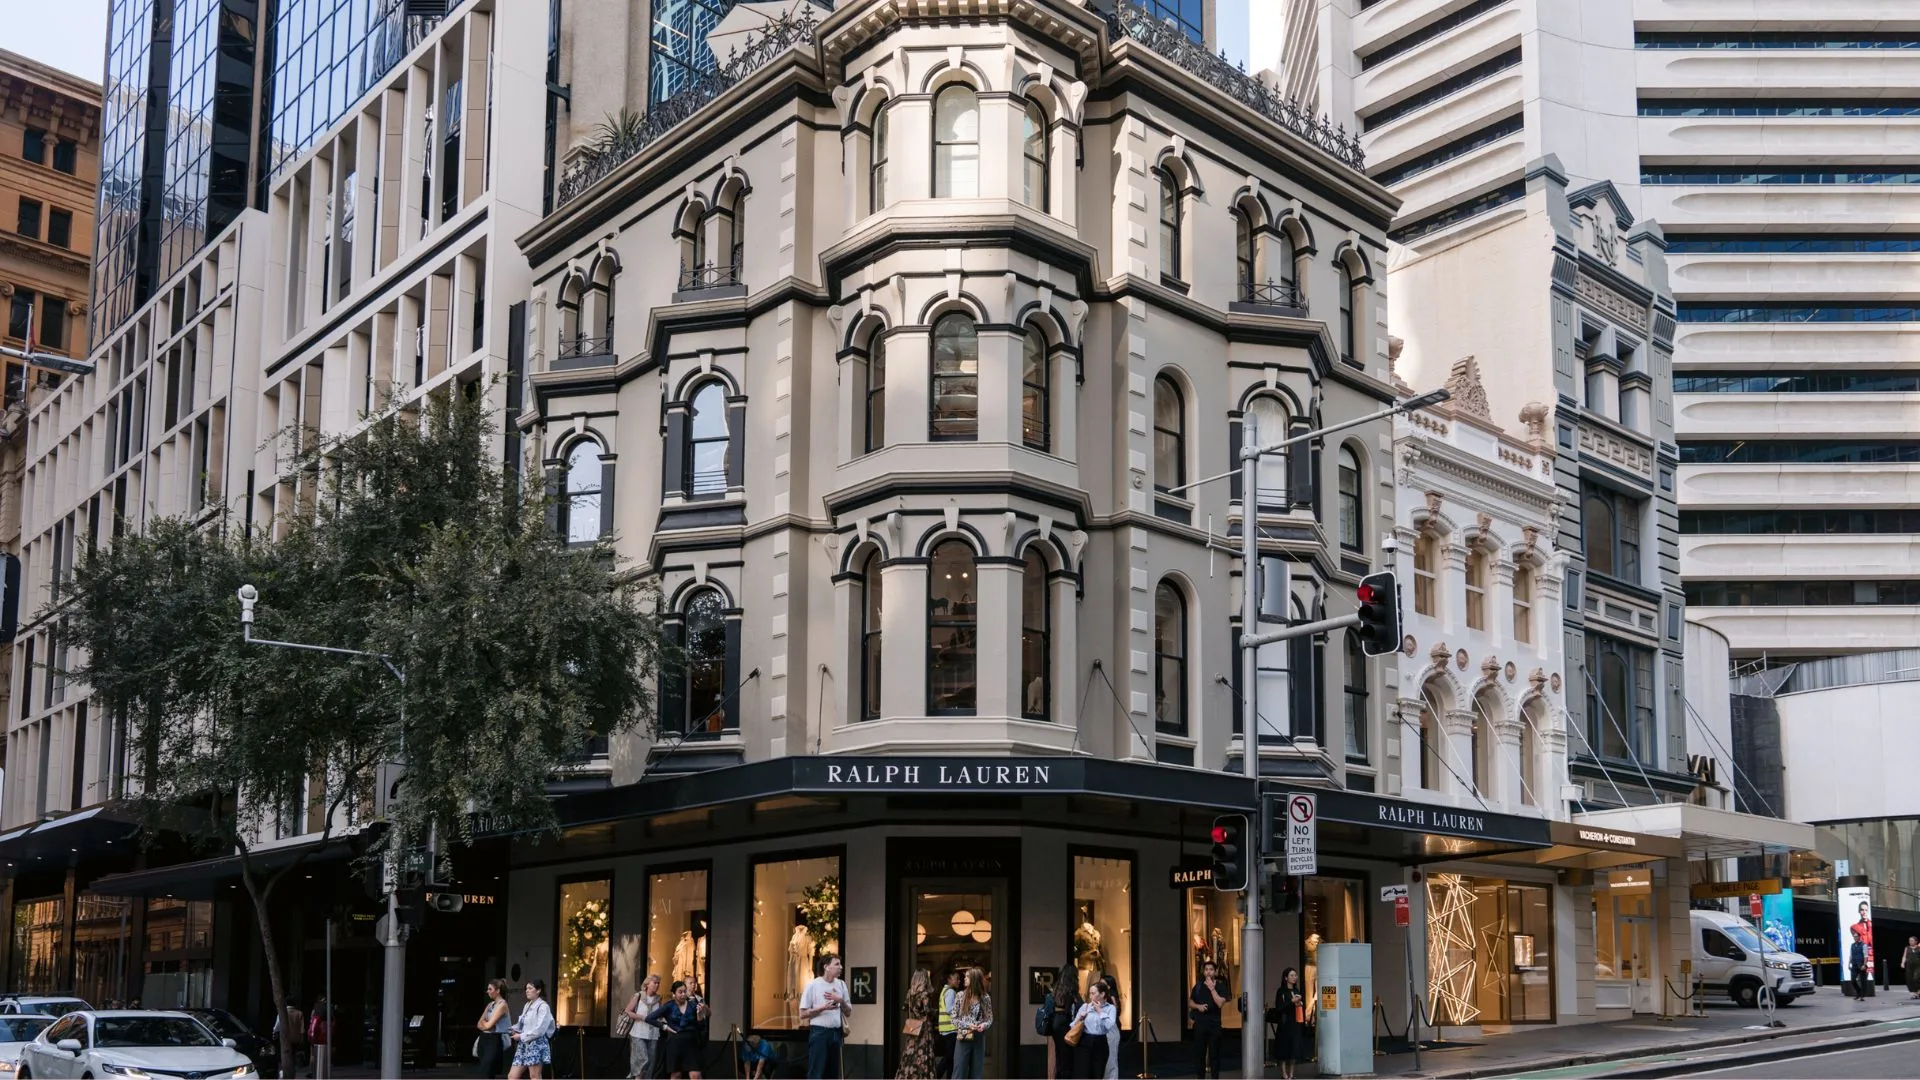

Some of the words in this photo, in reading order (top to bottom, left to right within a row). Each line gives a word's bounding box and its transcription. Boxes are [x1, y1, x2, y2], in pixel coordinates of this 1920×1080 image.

[827, 765, 920, 784] RALPH
[939, 765, 1050, 784] LAUREN
[1378, 804, 1425, 825] RALPH
[1432, 811, 1484, 832] LAUREN
[1294, 825, 1309, 835] NO
[1292, 837, 1311, 845] LEFT
[1292, 846, 1312, 854] TURN
[1174, 869, 1212, 883] RALPH
[463, 893, 495, 906] UREN
